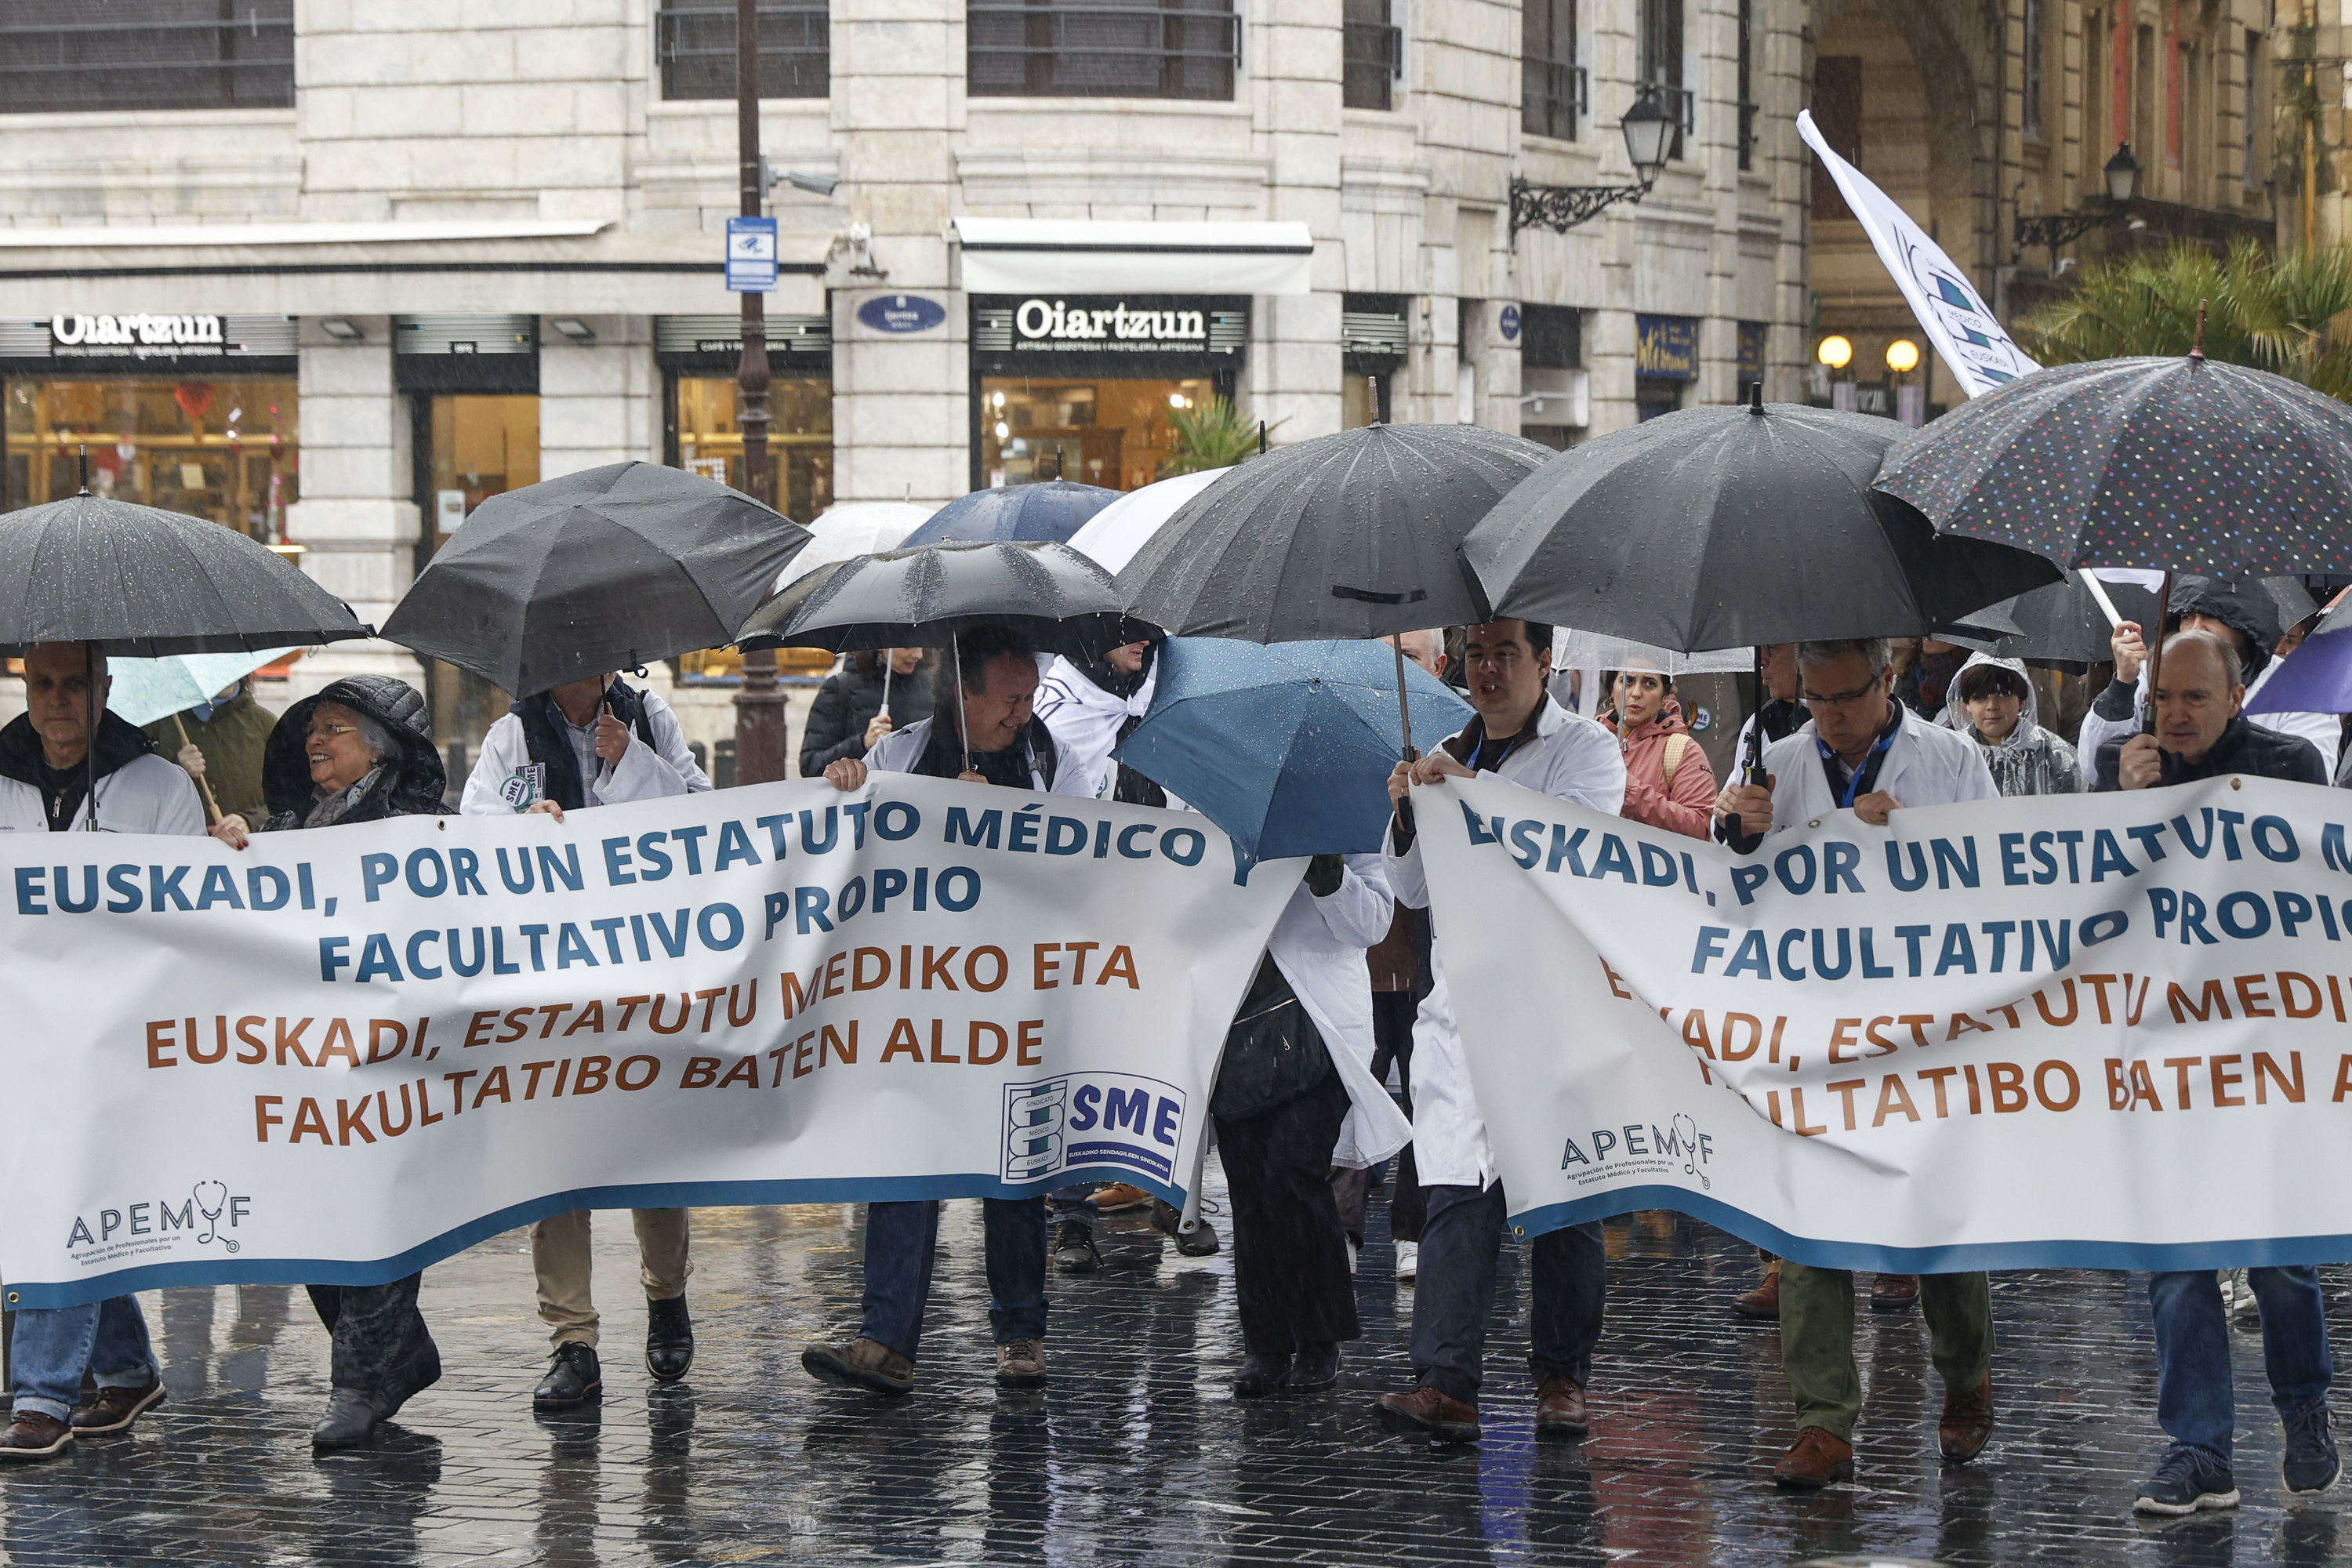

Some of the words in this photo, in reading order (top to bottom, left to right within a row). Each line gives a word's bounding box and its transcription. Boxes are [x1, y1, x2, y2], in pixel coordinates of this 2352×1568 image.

[1016, 299, 1207, 339] Oiartzun
[506, 780, 520, 802] SME
[14, 862, 338, 917] EUSKADI,
[361, 847, 488, 902] POR
[497, 843, 584, 895] UN
[603, 800, 921, 887] ESTATUTO
[943, 802, 1207, 868] MÉDICO
[1729, 841, 1866, 906] POR
[1884, 834, 1981, 892] UN
[1999, 807, 2301, 887] ESTATUTO
[320, 903, 745, 984] FACULTATIVO
[764, 866, 982, 941] PROPIO
[1690, 909, 2130, 982] FACULTATIVO
[2146, 887, 2352, 946] PROPI
[146, 1014, 441, 1069] EUSKADI,
[463, 978, 758, 1048] ESTATUTU
[780, 943, 1009, 1022] MEDIKO
[1033, 942, 1141, 990] ETA
[1828, 973, 2151, 1064] ESTATUTU
[2166, 971, 2352, 1024] MEDI
[254, 1055, 661, 1147] FAKULTATIBO
[679, 1018, 859, 1091] BATEN
[880, 1017, 1044, 1066] ALDE
[1025, 1095, 1054, 1108] SINDICATO
[2104, 1051, 2307, 1112] BATEN
[1029, 1126, 1050, 1136] MÉDICO
[1069, 1083, 1181, 1147] SME
[1026, 1155, 1049, 1166] EUSKADI
[1069, 1149, 1098, 1158] EUSKADIKO
[1099, 1149, 1140, 1160] SENDAGILEEN
[1140, 1156, 1170, 1174] SINDIKATUA
[1567, 1167, 1604, 1180] Agrupación
[1614, 1159, 1657, 1169] Profesionales
[1578, 1174, 1606, 1185] Estatuto
[1607, 1168, 1631, 1178] Médico
[71, 1247, 106, 1261] Agrupación
[115, 1238, 158, 1250] Profesionales
[81, 1256, 107, 1266] Estatuto
[107, 1251, 129, 1261] Médico
[135, 1244, 172, 1255] Facultativo
